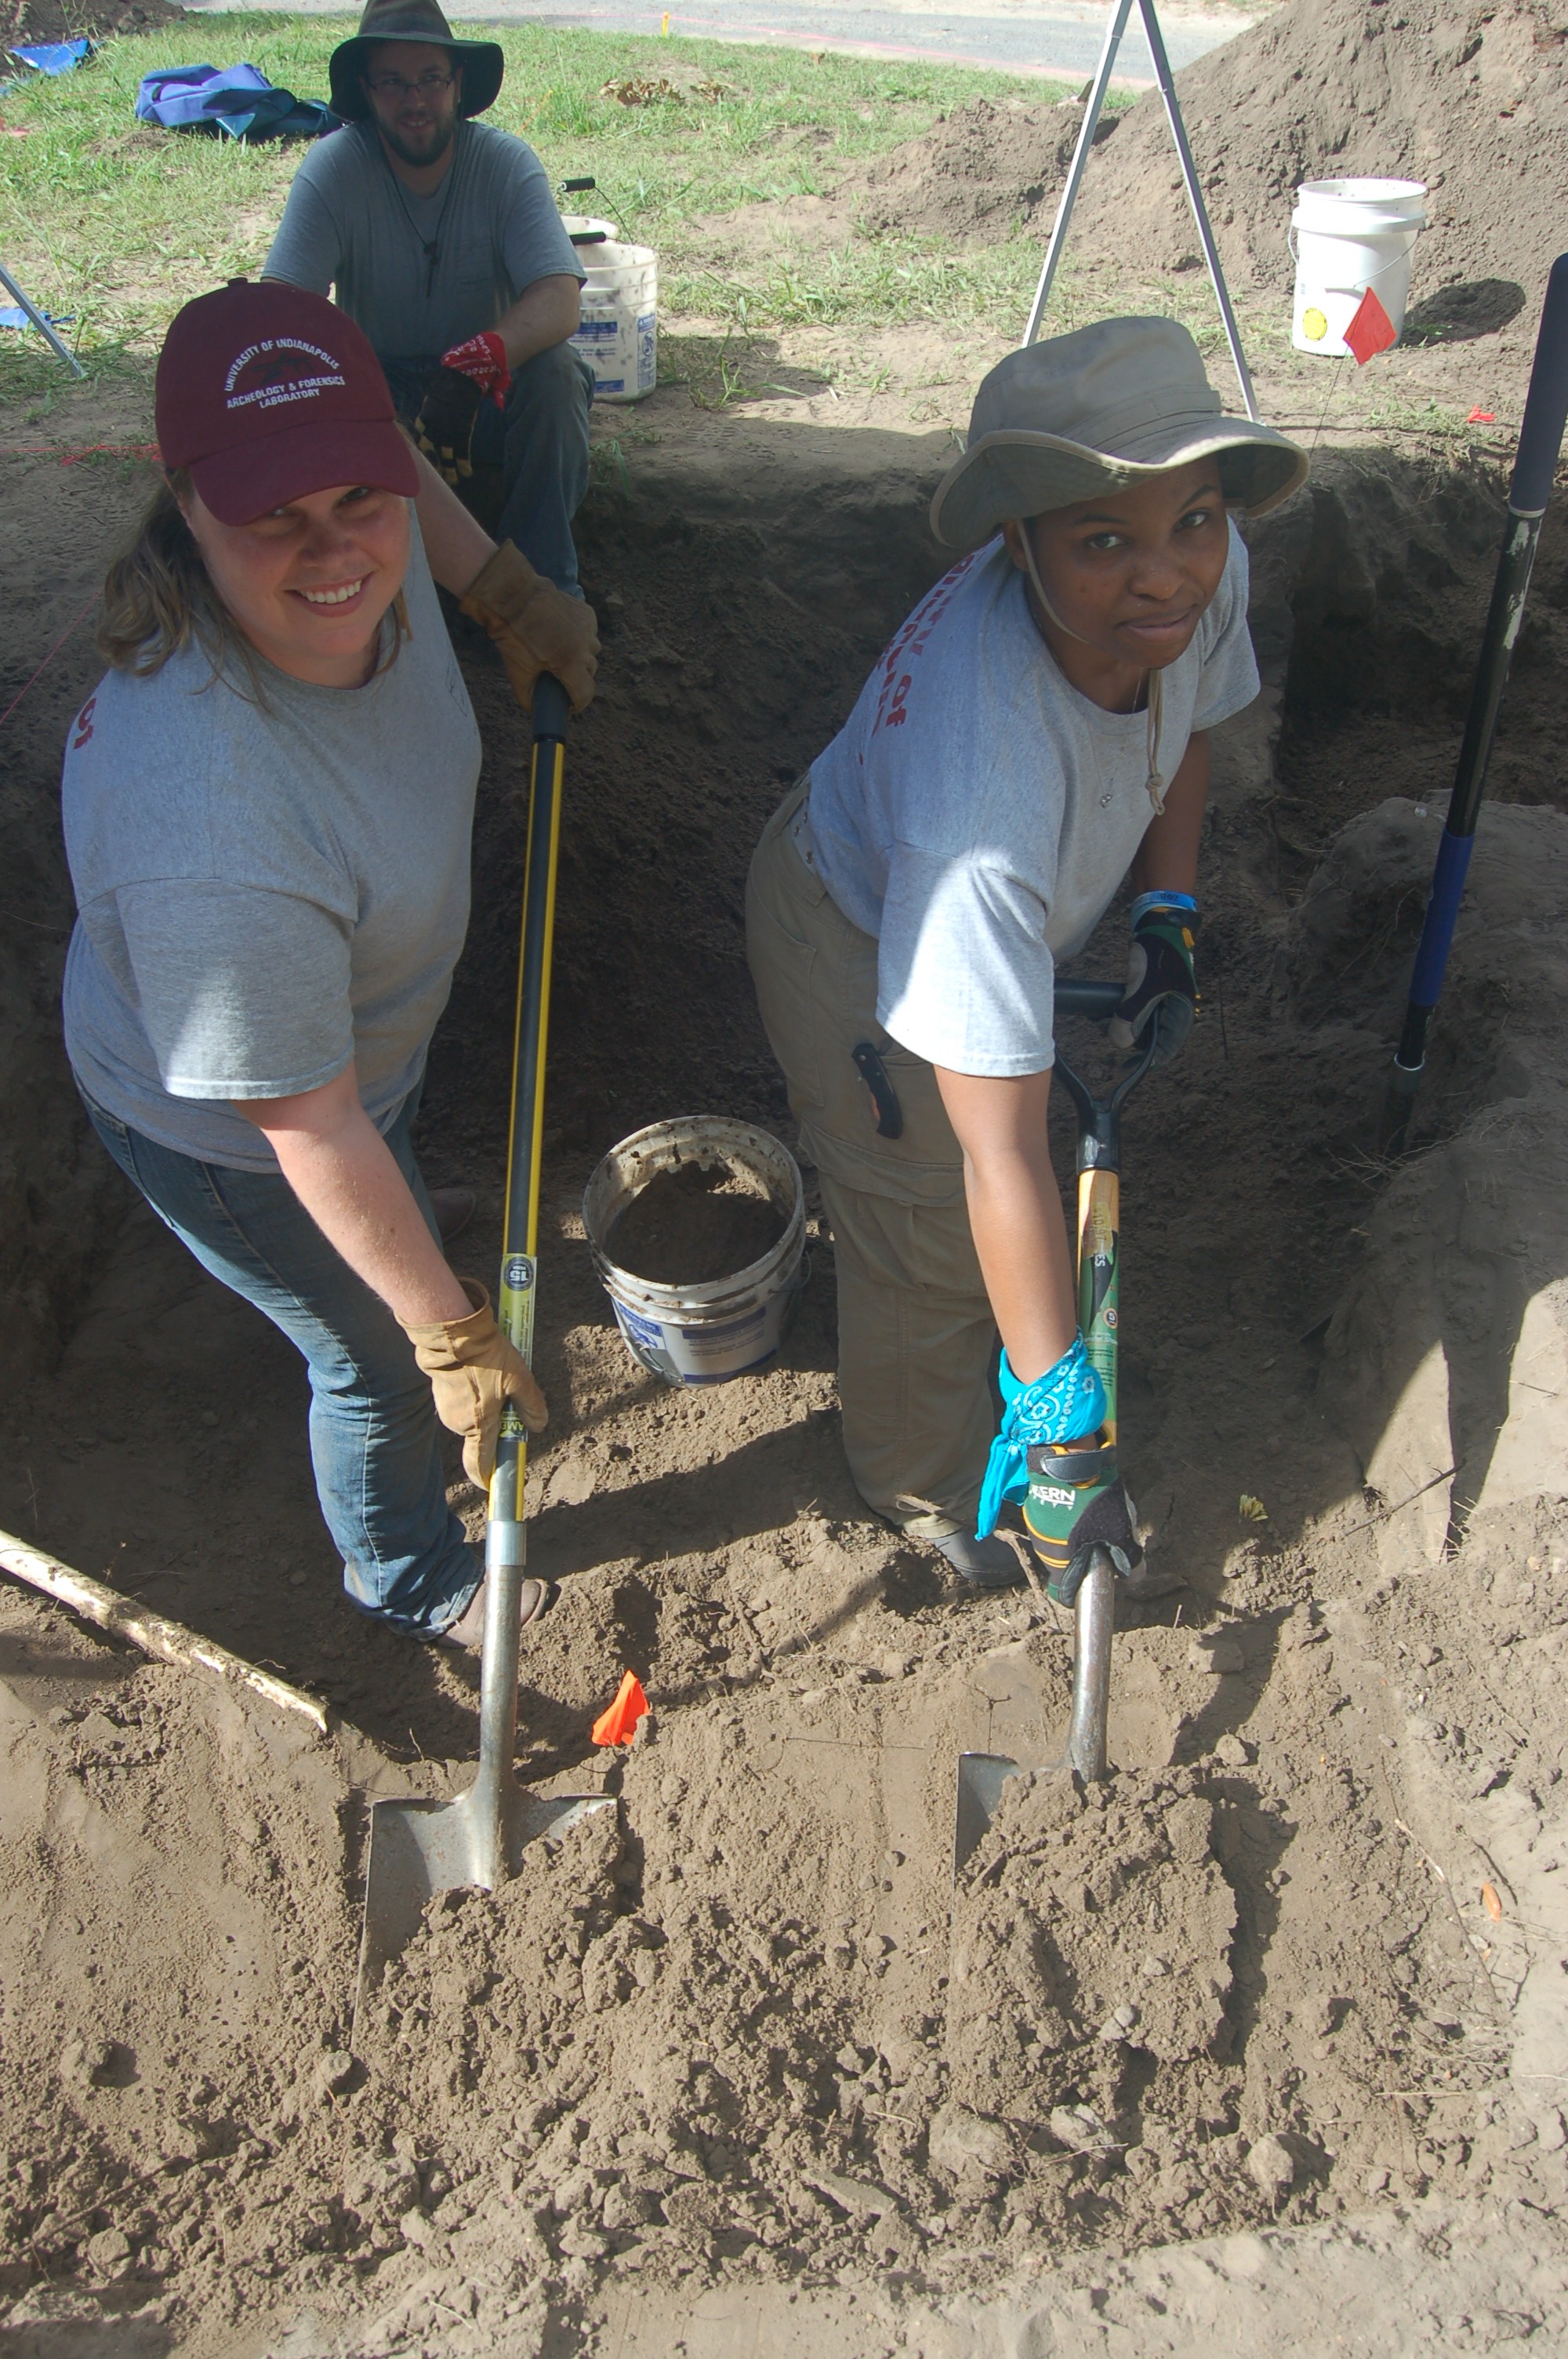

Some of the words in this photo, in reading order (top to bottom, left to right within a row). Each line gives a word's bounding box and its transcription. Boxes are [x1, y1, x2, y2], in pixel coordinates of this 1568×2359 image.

[224, 345, 260, 391] UNIVERSITY
[261, 340, 274, 351] OF
[276, 338, 340, 369] INDIANAPOLIS
[227, 384, 285, 409] ARCHEOLOGY
[289, 383, 296, 391] &
[298, 376, 346, 390] FORENSICS
[260, 388, 320, 409] LABORATORY
[510, 1270, 528, 1281] 15
[500, 1421, 524, 1431] AME
